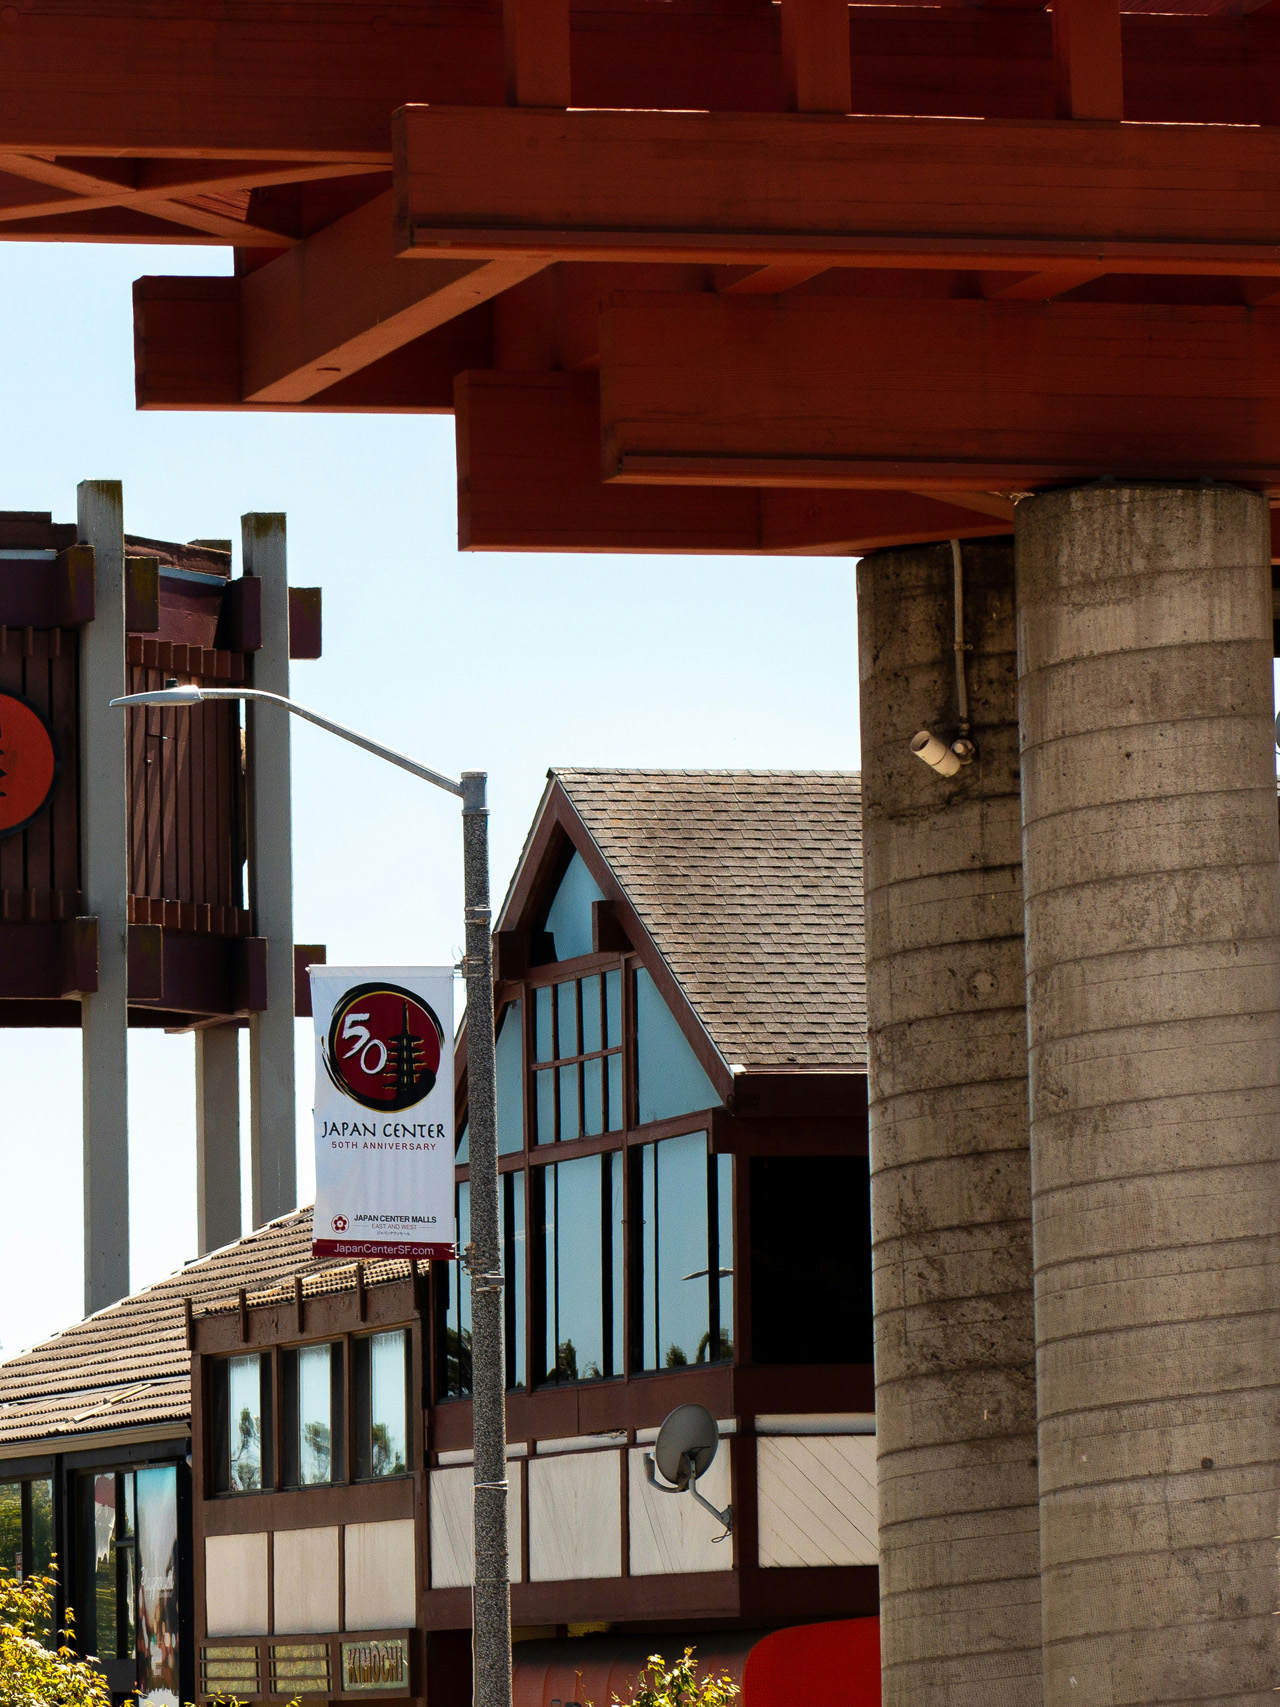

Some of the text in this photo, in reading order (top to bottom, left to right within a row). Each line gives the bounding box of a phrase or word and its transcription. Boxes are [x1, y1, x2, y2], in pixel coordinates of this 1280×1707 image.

[342, 1012, 388, 1075] 50
[321, 1120, 446, 1139] JAPAN CENTER
[331, 1140, 437, 1151] 50TH ANNIVERSARY
[354, 1214, 437, 1224] JAPAN CENTER MALLS
[334, 1243, 435, 1256] JapanCenterSF.com
[347, 1645, 404, 1684] KIMOCHI
